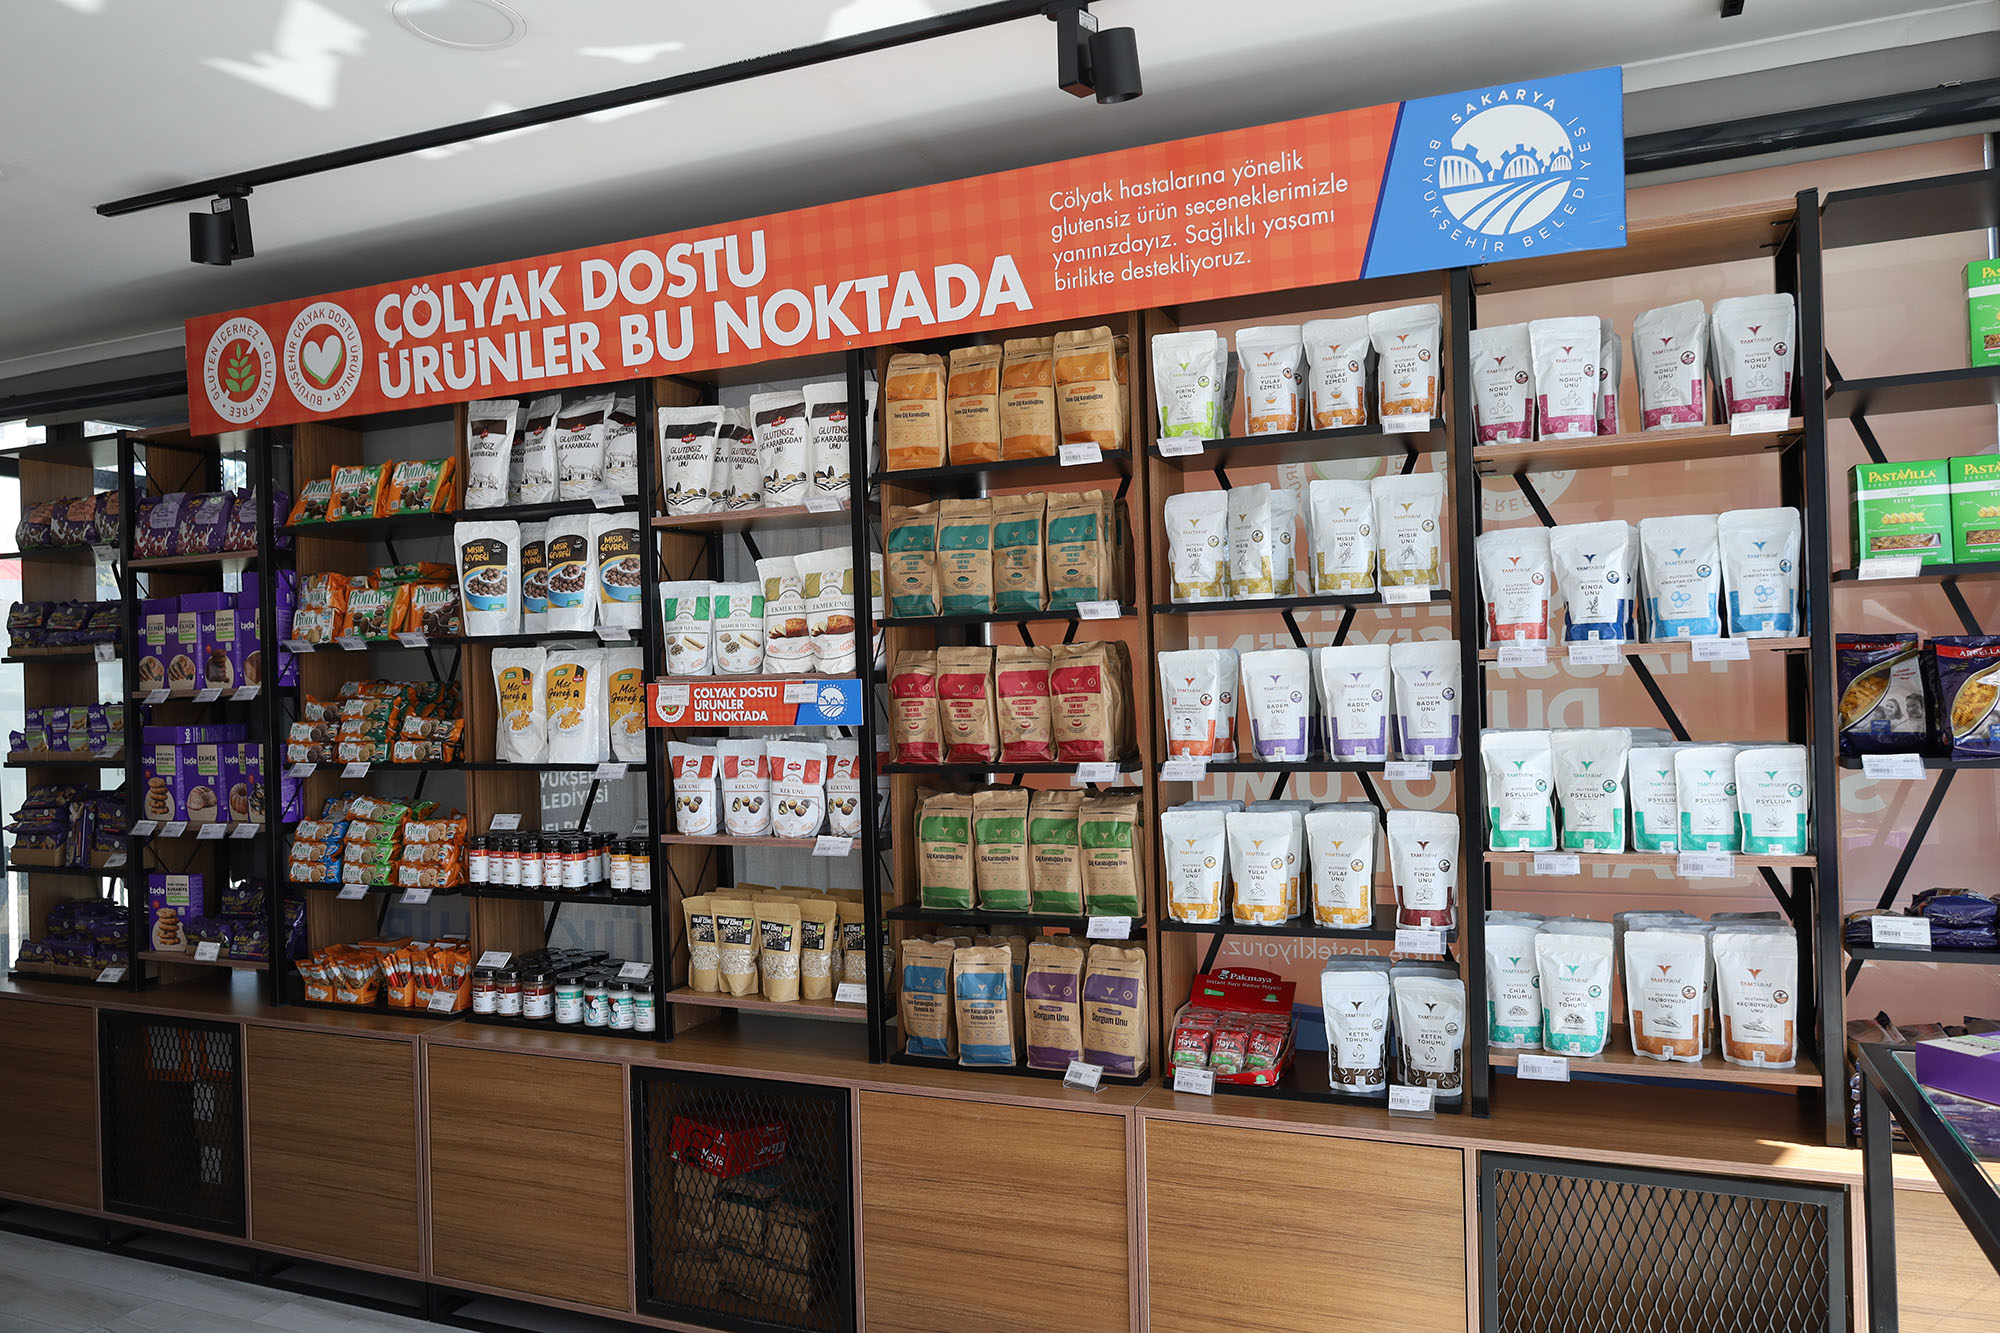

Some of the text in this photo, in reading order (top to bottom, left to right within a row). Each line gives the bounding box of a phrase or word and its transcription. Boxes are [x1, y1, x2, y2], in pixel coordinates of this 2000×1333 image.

[1451, 89, 1556, 124] SAKARYA
[1049, 149, 1304, 212] Çölyak hastalarına yönelik
[1422, 116, 1592, 252] BÜYÜKŞEHİR BELEDİYESİ
[1051, 173, 1348, 243] glutensiz ürün seçeneklerimizle
[1052, 209, 1335, 269] yanınızdayız. Sağlıklı yaşamı
[1054, 251, 1251, 291] birlikte destekliyoruz.
[374, 229, 767, 348] ÇÖLYAK DOSTU
[378, 254, 1034, 399] ÜRÜNLER BU NOKTADA
[207, 323, 260, 400] GLUTEN İÇERMEZ
[288, 308, 361, 406] BÜYÜKŞEHİR ÇÖLYAK DOSTU ÜRÜNLER
[1744, 356, 1771, 364] NOHUT
[1654, 366, 1678, 375] NOHUT
[229, 351, 272, 418] GLUTEN FREE
[774, 446, 784, 454] UNU
[1868, 469, 1936, 482] PASTAVILLA
[604, 535, 624, 544] MISIR
[600, 541, 628, 551] GEVREĞİ
[771, 605, 792, 613] EKMEK
[693, 686, 737, 700] ÇÖLYAK
[739, 686, 778, 698] DOSTU
[693, 699, 744, 710] ÜRÜNLER
[694, 710, 768, 722] BU NOKTADA
[142, 757, 155, 765] tada
[184, 757, 197, 765] tada
[225, 756, 238, 764] tada
[246, 756, 258, 765] tada
[150, 886, 165, 895] tada
[1230, 974, 1272, 983] Pakmaya
[1033, 1011, 1069, 1022] Sorgum Unu
[1092, 1013, 1128, 1027] Sorgum Unu
[1177, 1039, 1198, 1048] Maya
[1216, 1039, 1235, 1049] Maya
[1251, 1042, 1270, 1052] Maya
